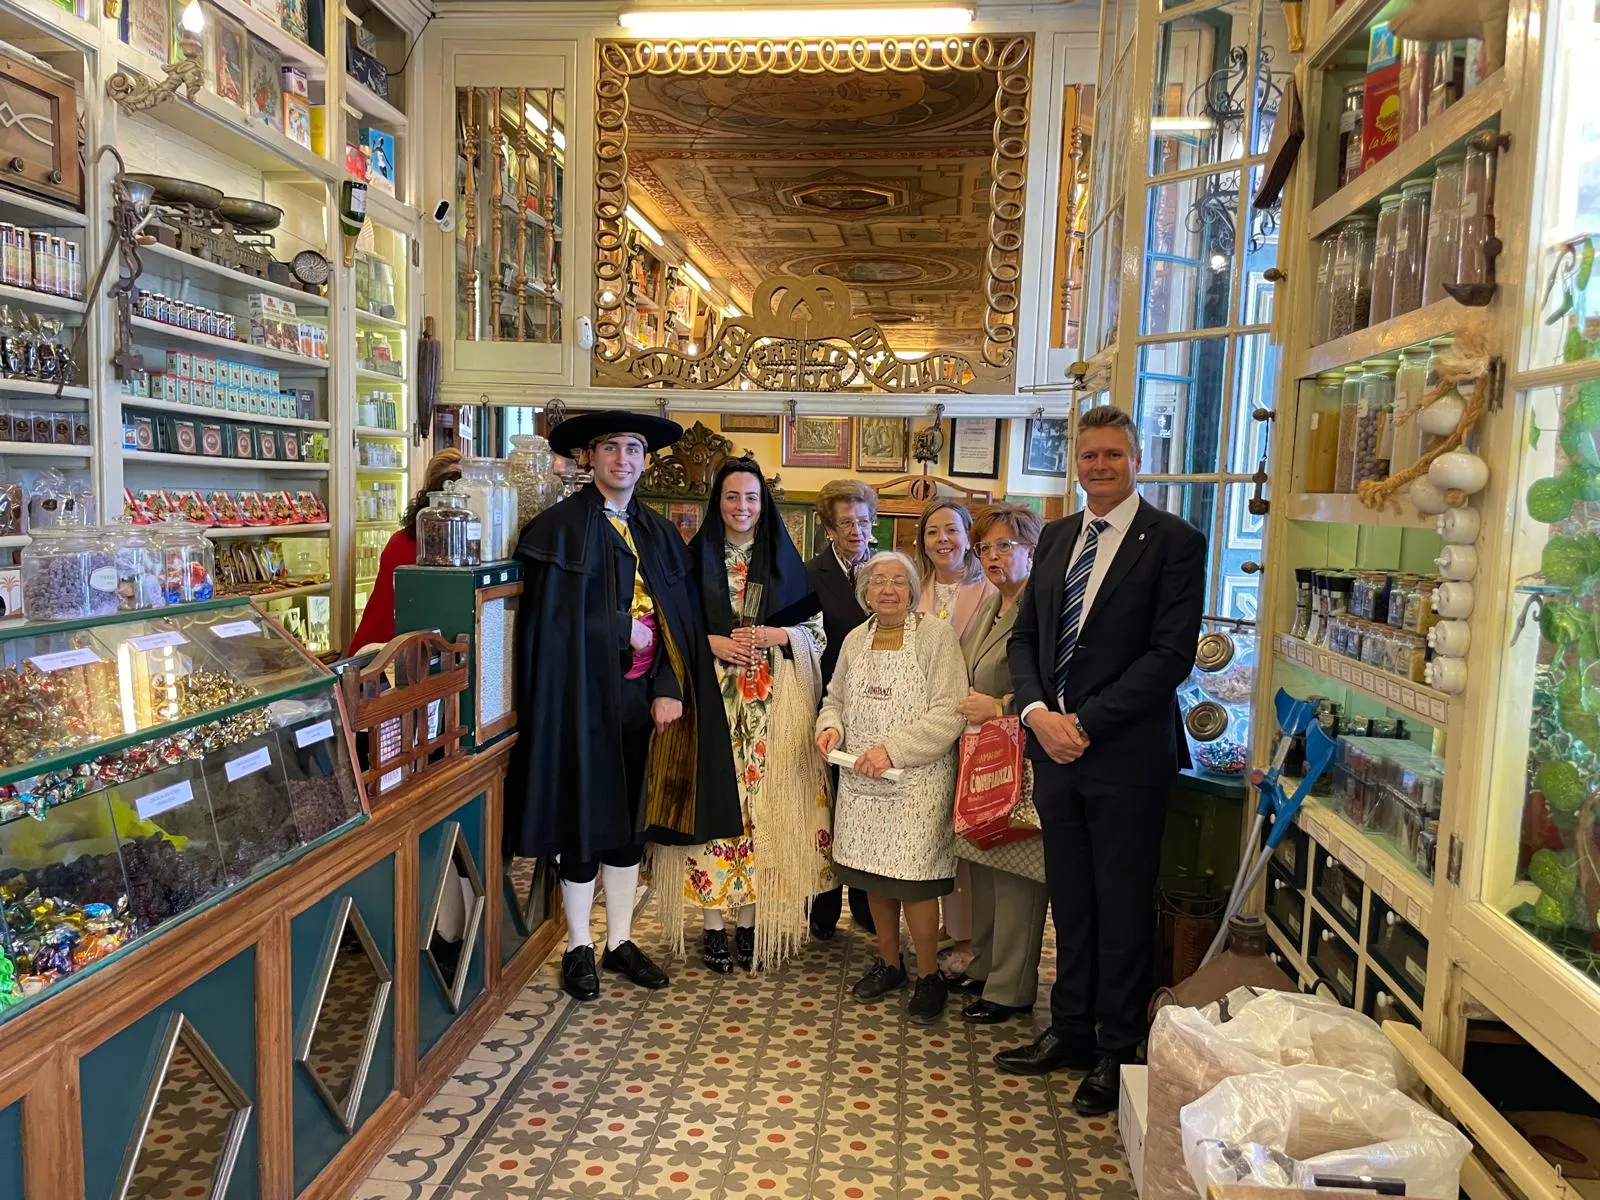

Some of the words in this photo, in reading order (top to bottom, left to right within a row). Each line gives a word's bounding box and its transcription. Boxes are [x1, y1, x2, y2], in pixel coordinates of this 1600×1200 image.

[631, 327, 745, 382] COMERCIO
[752, 342, 849, 366] PRECIO
[760, 368, 841, 389] FIJO
